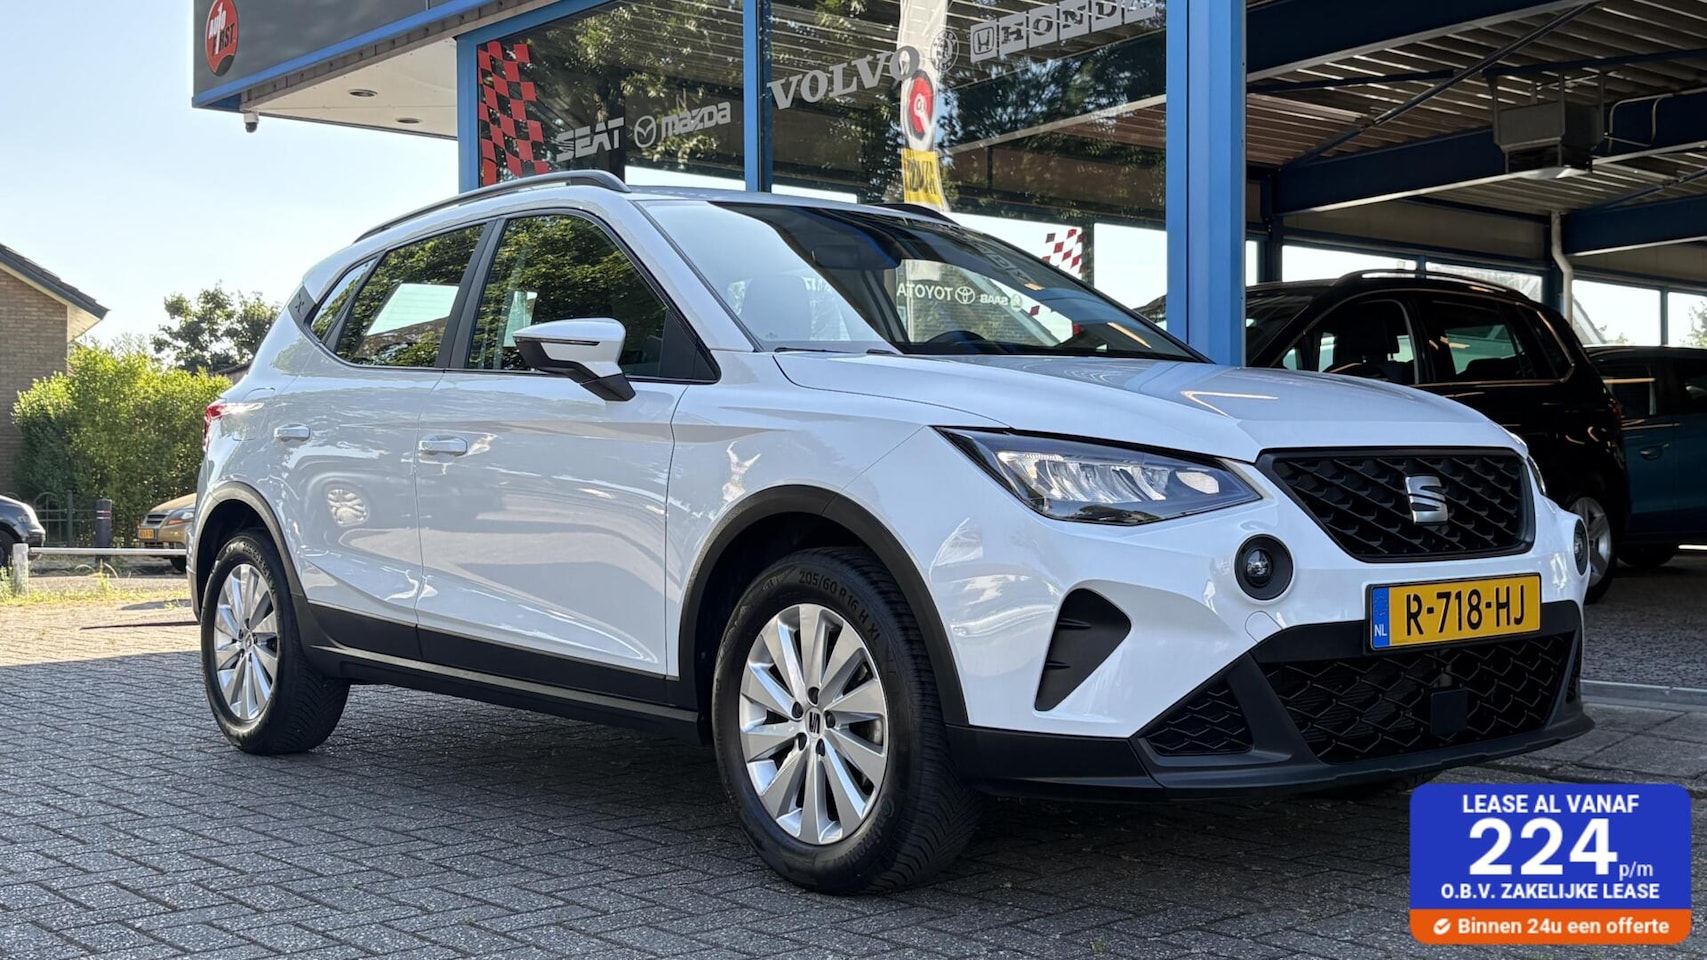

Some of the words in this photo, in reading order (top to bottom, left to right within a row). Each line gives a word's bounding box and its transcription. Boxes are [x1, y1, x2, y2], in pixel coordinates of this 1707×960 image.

[766, 45, 920, 110] VOLVO
[556, 116, 624, 163] SEAT
[799, 570, 838, 594] 205/60
[839, 586, 847, 598] R
[847, 595, 860, 611] 16
[859, 608, 869, 624] H
[1406, 585, 1525, 636] R-718-HJ
[1374, 623, 1388, 637] NL
